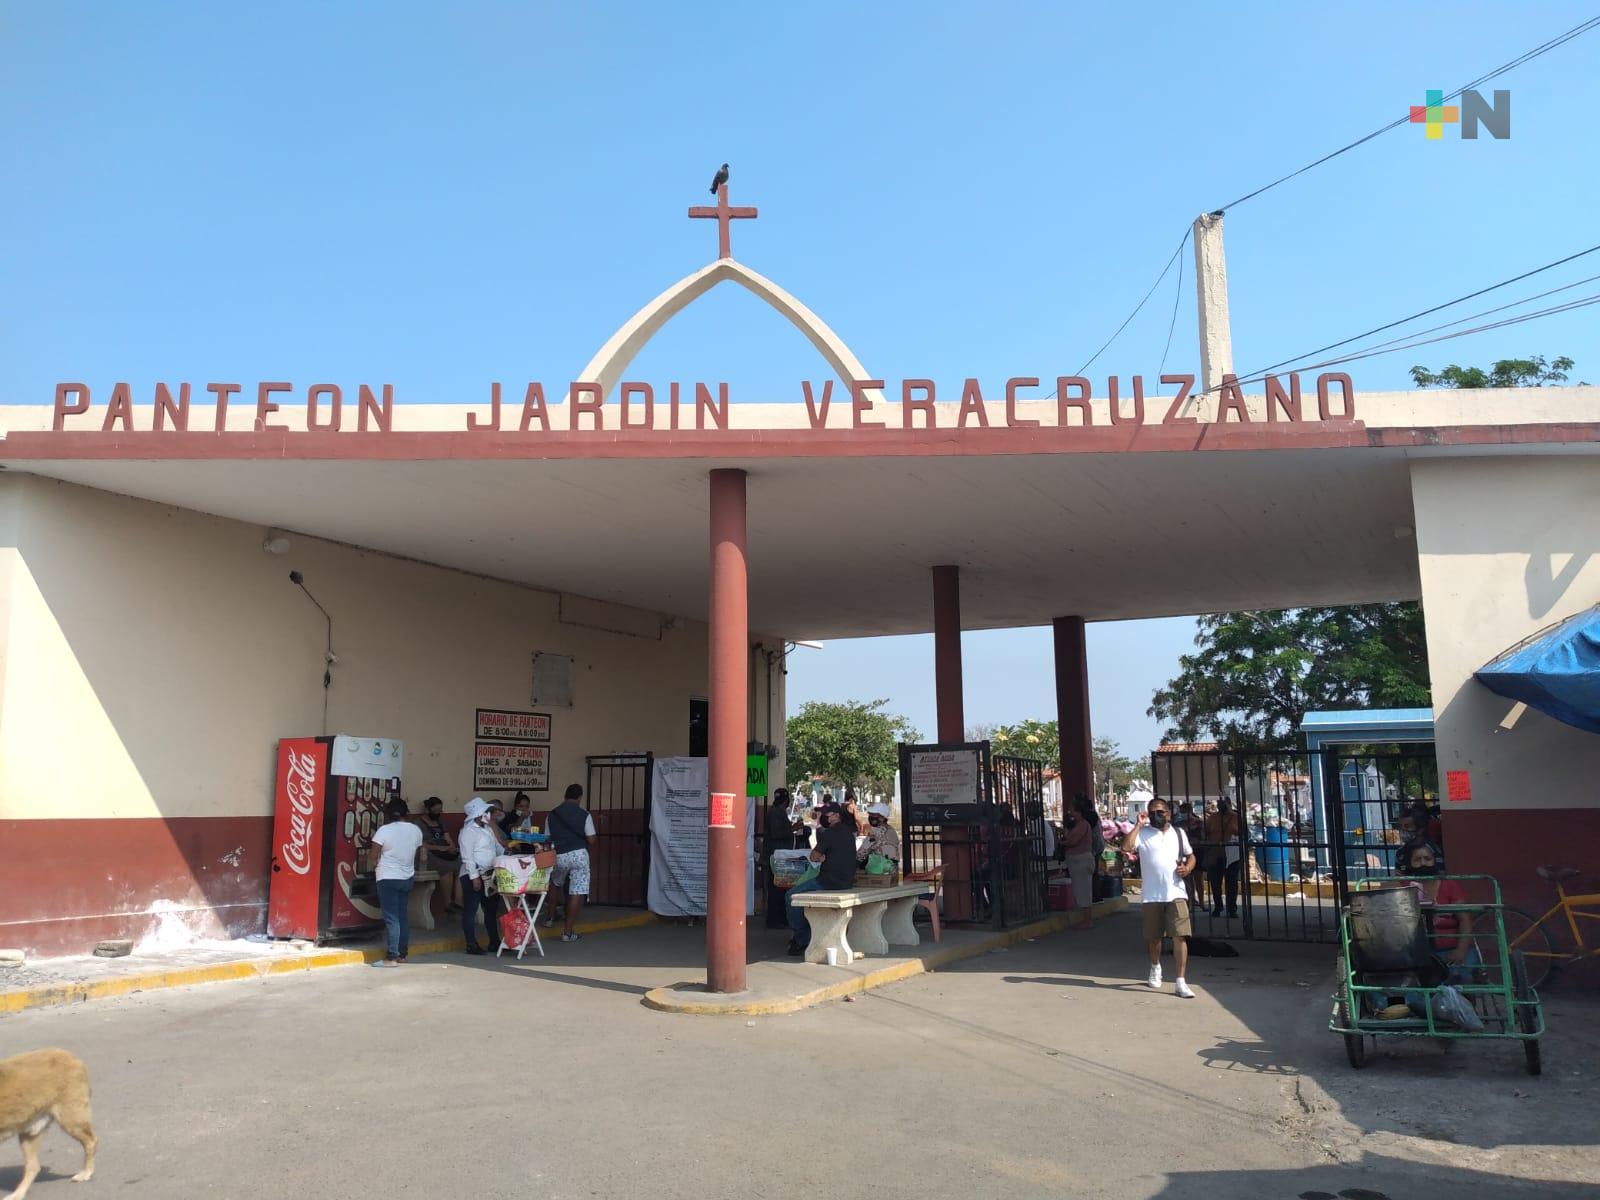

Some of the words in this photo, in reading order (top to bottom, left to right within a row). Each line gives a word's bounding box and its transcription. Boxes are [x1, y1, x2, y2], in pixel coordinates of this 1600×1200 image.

[53, 383, 393, 433] PANTEON
[466, 383, 729, 433] JARDIN
[801, 373, 1357, 430] VERACRUZANO
[480, 713, 507, 726] HORARIO
[509, 716, 518, 727] DE
[519, 716, 545, 728] PANTEON
[483, 727, 493, 735] DE
[478, 746, 506, 757] HORARIO
[508, 748, 517, 757] DE
[518, 748, 544, 759] OFICINA
[480, 758, 499, 766] LUNES
[505, 759, 510, 767] A
[517, 759, 542, 767] SABADO
[479, 777, 501, 785] DOMINGO
[283, 746, 316, 875] Coca-Cola
